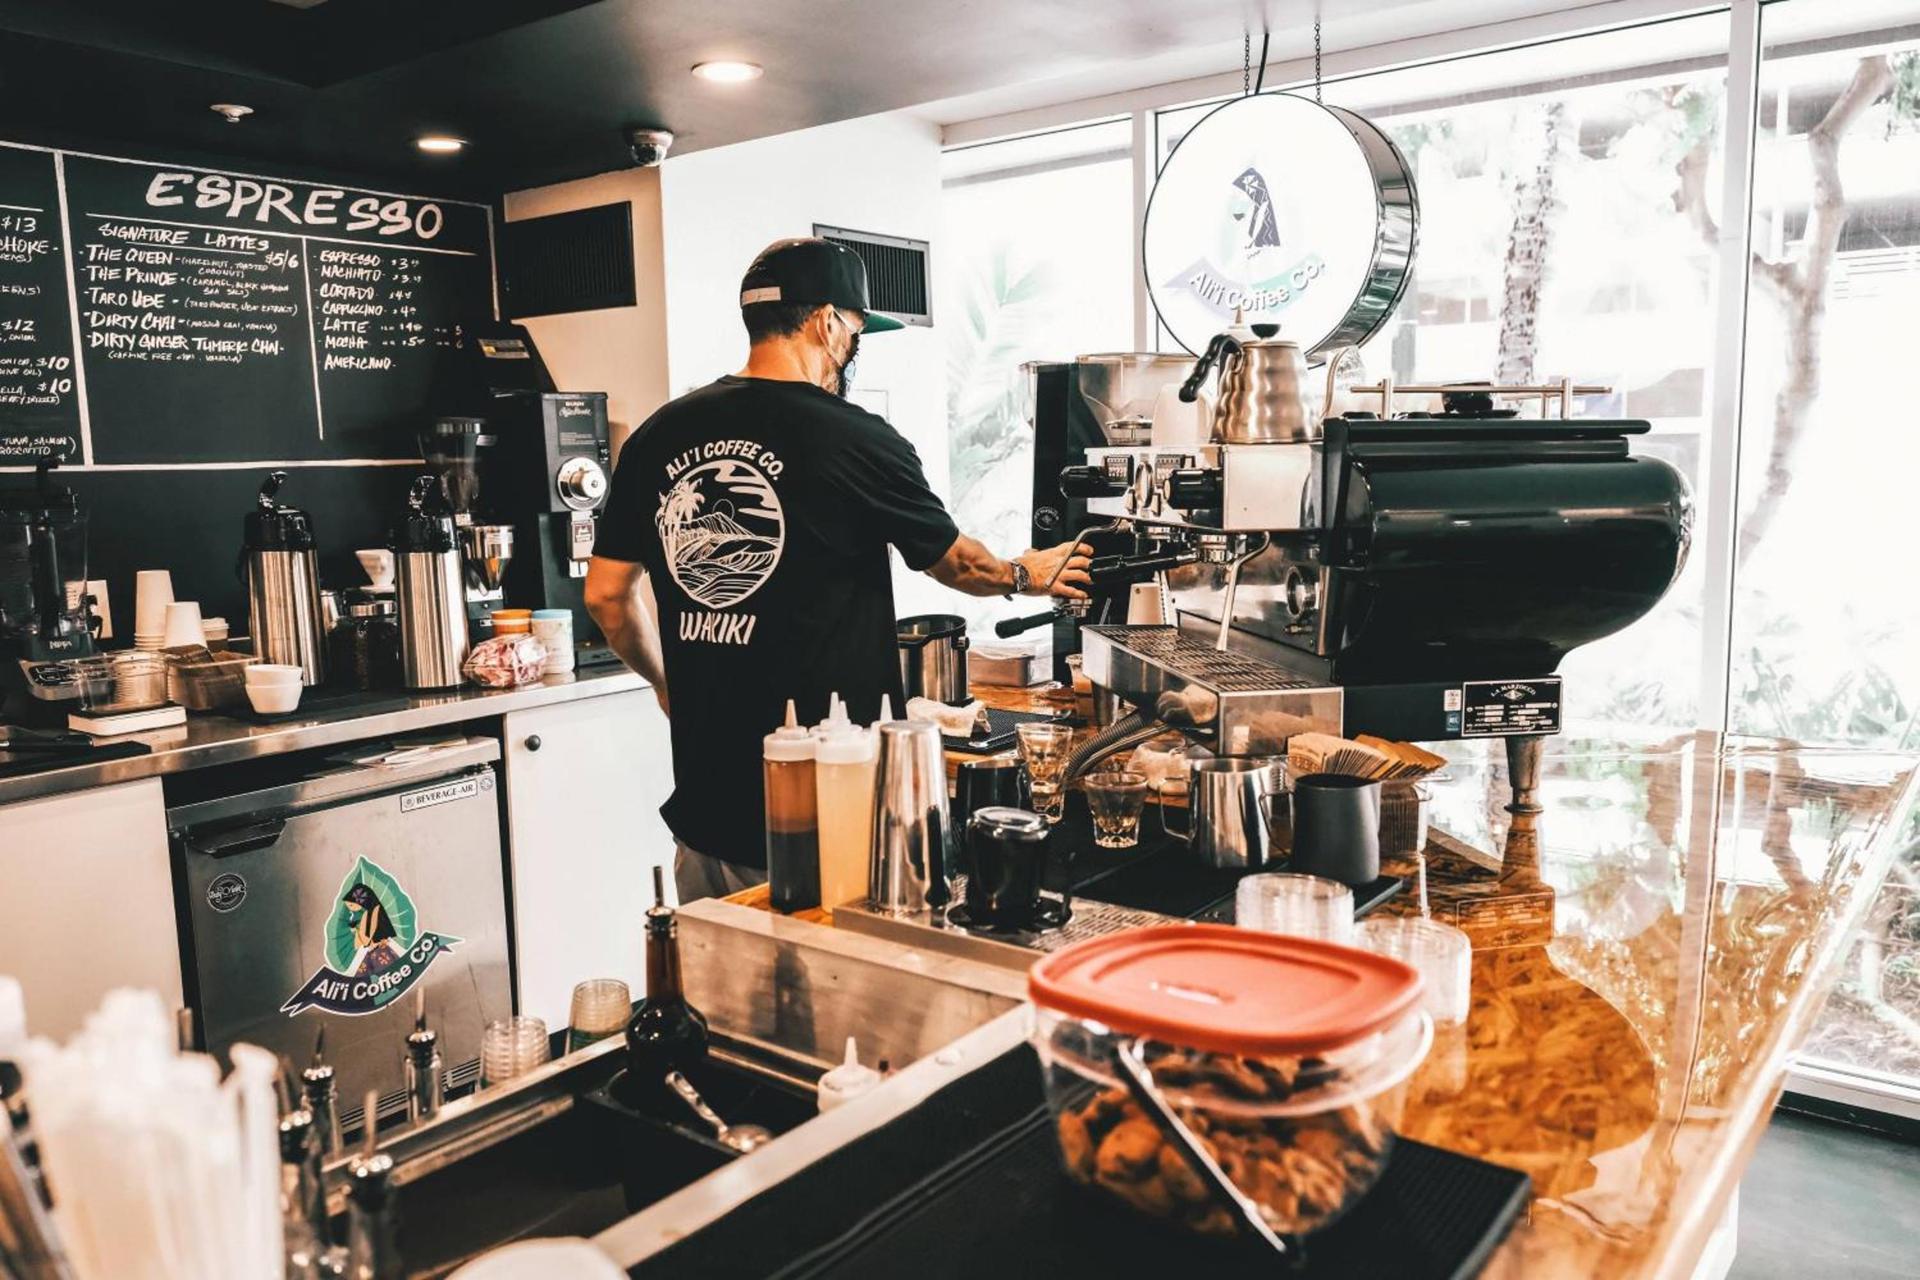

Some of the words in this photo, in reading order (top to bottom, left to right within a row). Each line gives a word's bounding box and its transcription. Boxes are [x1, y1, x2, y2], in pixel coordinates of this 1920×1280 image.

[145, 173, 443, 240] ESPRESSO
[98, 222, 190, 245] SIGNATURE
[204, 233, 270, 251] LATTES
[86, 244, 122, 262] THE
[125, 248, 173, 265] QUEEN
[265, 249, 299, 273] $5/6
[319, 250, 381, 266] ESPRESSO
[86, 265, 122, 282] THE
[125, 267, 178, 286] PRINCE
[88, 287, 128, 306] TARO
[131, 289, 166, 309] UBE
[319, 283, 375, 299] CORTADO
[322, 300, 384, 317] CAPPUCCINO
[1, 319, 34, 331] $12
[90, 310, 138, 330] DIRTY
[140, 311, 176, 332] CHAI
[323, 317, 370, 334] LATTE
[90, 331, 136, 351] DIRTY
[325, 335, 367, 349] MOCHA
[36, 356, 70, 370] $10
[37, 378, 71, 393] $10
[703, 439, 763, 460] COFFEE
[758, 451, 784, 481] CO.
[352, 964, 412, 1000] Coffee
[410, 935, 438, 963] Co.
